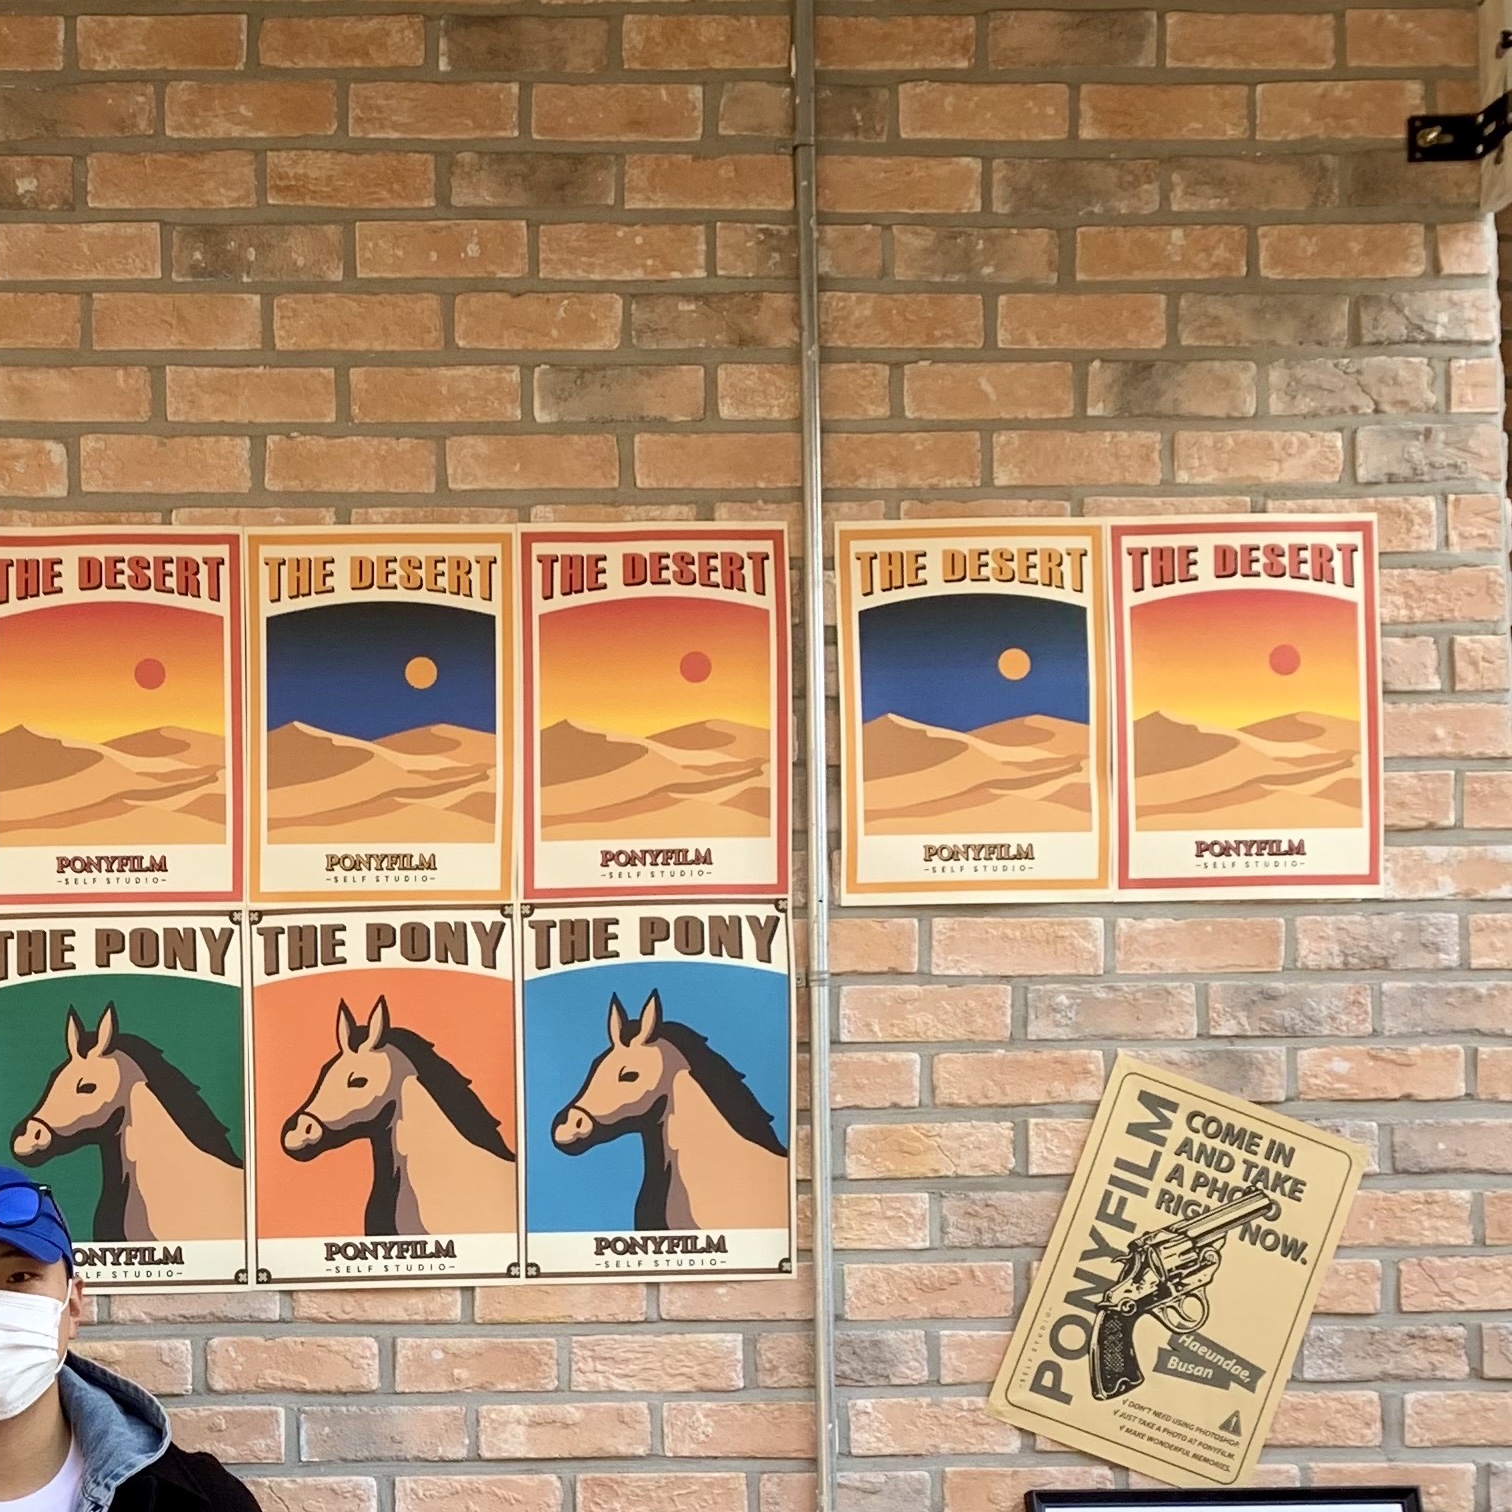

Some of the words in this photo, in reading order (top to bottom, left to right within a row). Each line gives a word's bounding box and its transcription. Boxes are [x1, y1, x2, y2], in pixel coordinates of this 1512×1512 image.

[79, 556, 224, 602] DESERT
[265, 558, 335, 603] THE
[351, 557, 497, 601] DESERT
[537, 555, 607, 600] THE
[623, 552, 769, 596] DESERT
[856, 551, 927, 597] THE
[944, 549, 1087, 593] DESERT
[1127, 546, 1199, 592] THE
[1214, 544, 1358, 588] DESERT
[56, 855, 168, 873] PONYFILM
[325, 854, 437, 871] PONYFILM
[600, 848, 713, 867] PONYFILM
[923, 843, 1035, 862] PONYFILM
[1195, 839, 1306, 857] PONYFILM
[95, 928, 234, 976] PONY
[257, 924, 347, 976] THE
[366, 921, 506, 970] PONY
[529, 918, 620, 970] THE
[640, 915, 780, 963] PONY
[1186, 1110, 1263, 1156] COME
[1264, 1138, 1296, 1168] IN
[1165, 1163, 1185, 1188] A
[1190, 1171, 1282, 1221] PHOO
[1174, 1136, 1236, 1173] AND
[1242, 1158, 1307, 1203] TAKE
[594, 1235, 728, 1255] PONYFILM
[1029, 1089, 1179, 1405] PONYFILM
[1155, 1188, 1212, 1220] RIG
[1238, 1222, 1309, 1265] NOW.
[72, 1246, 184, 1266] ONYFILM
[324, 1240, 457, 1261] PONYFILM
[74, 1271, 101, 1279] ELF
[1167, 1356, 1214, 1379] Busan
[1178, 1333, 1251, 1383] Haeundae,
